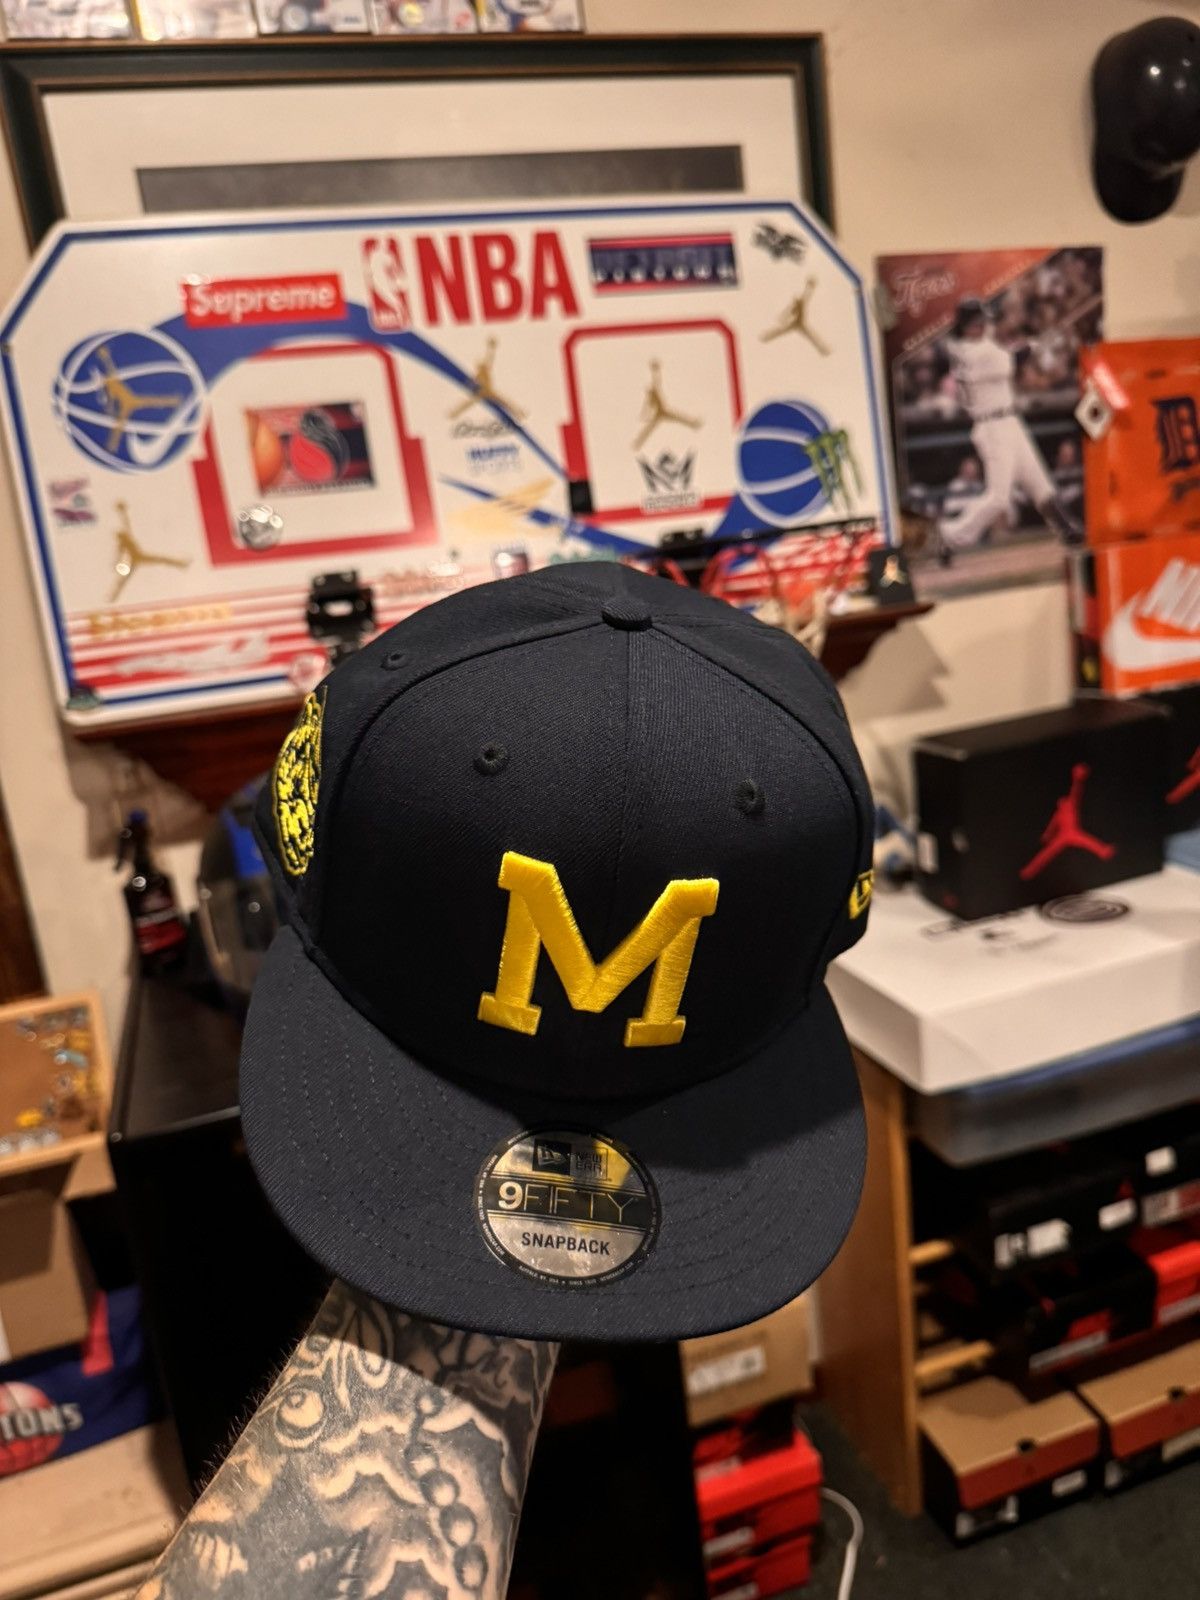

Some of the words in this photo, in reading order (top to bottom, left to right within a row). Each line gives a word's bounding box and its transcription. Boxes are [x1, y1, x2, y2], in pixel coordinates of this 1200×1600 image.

[414, 230, 580, 327] NBA
[190, 281, 336, 322] Supreme
[477, 850, 720, 1048] M
[498, 1181, 634, 1223] 9FIFTY
[521, 1232, 610, 1256] SNAPBACK
